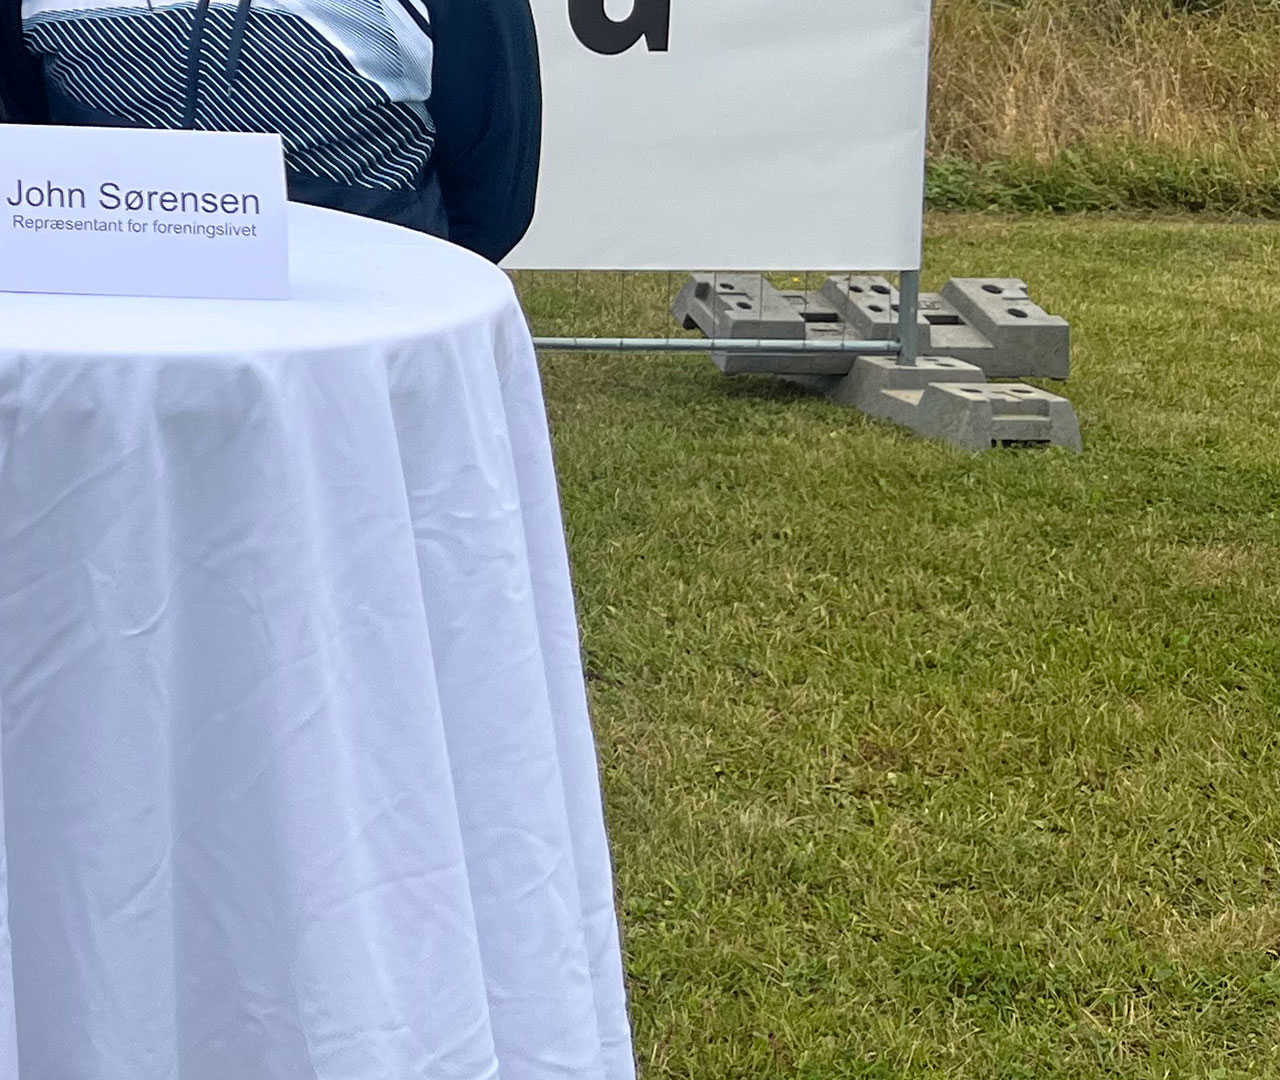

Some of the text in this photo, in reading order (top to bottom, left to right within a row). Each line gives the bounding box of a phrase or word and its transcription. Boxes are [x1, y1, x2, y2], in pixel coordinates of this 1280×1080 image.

[7, 180, 260, 214] John Sørensen
[13, 215, 256, 238] Repræsentant for foreningslivet
